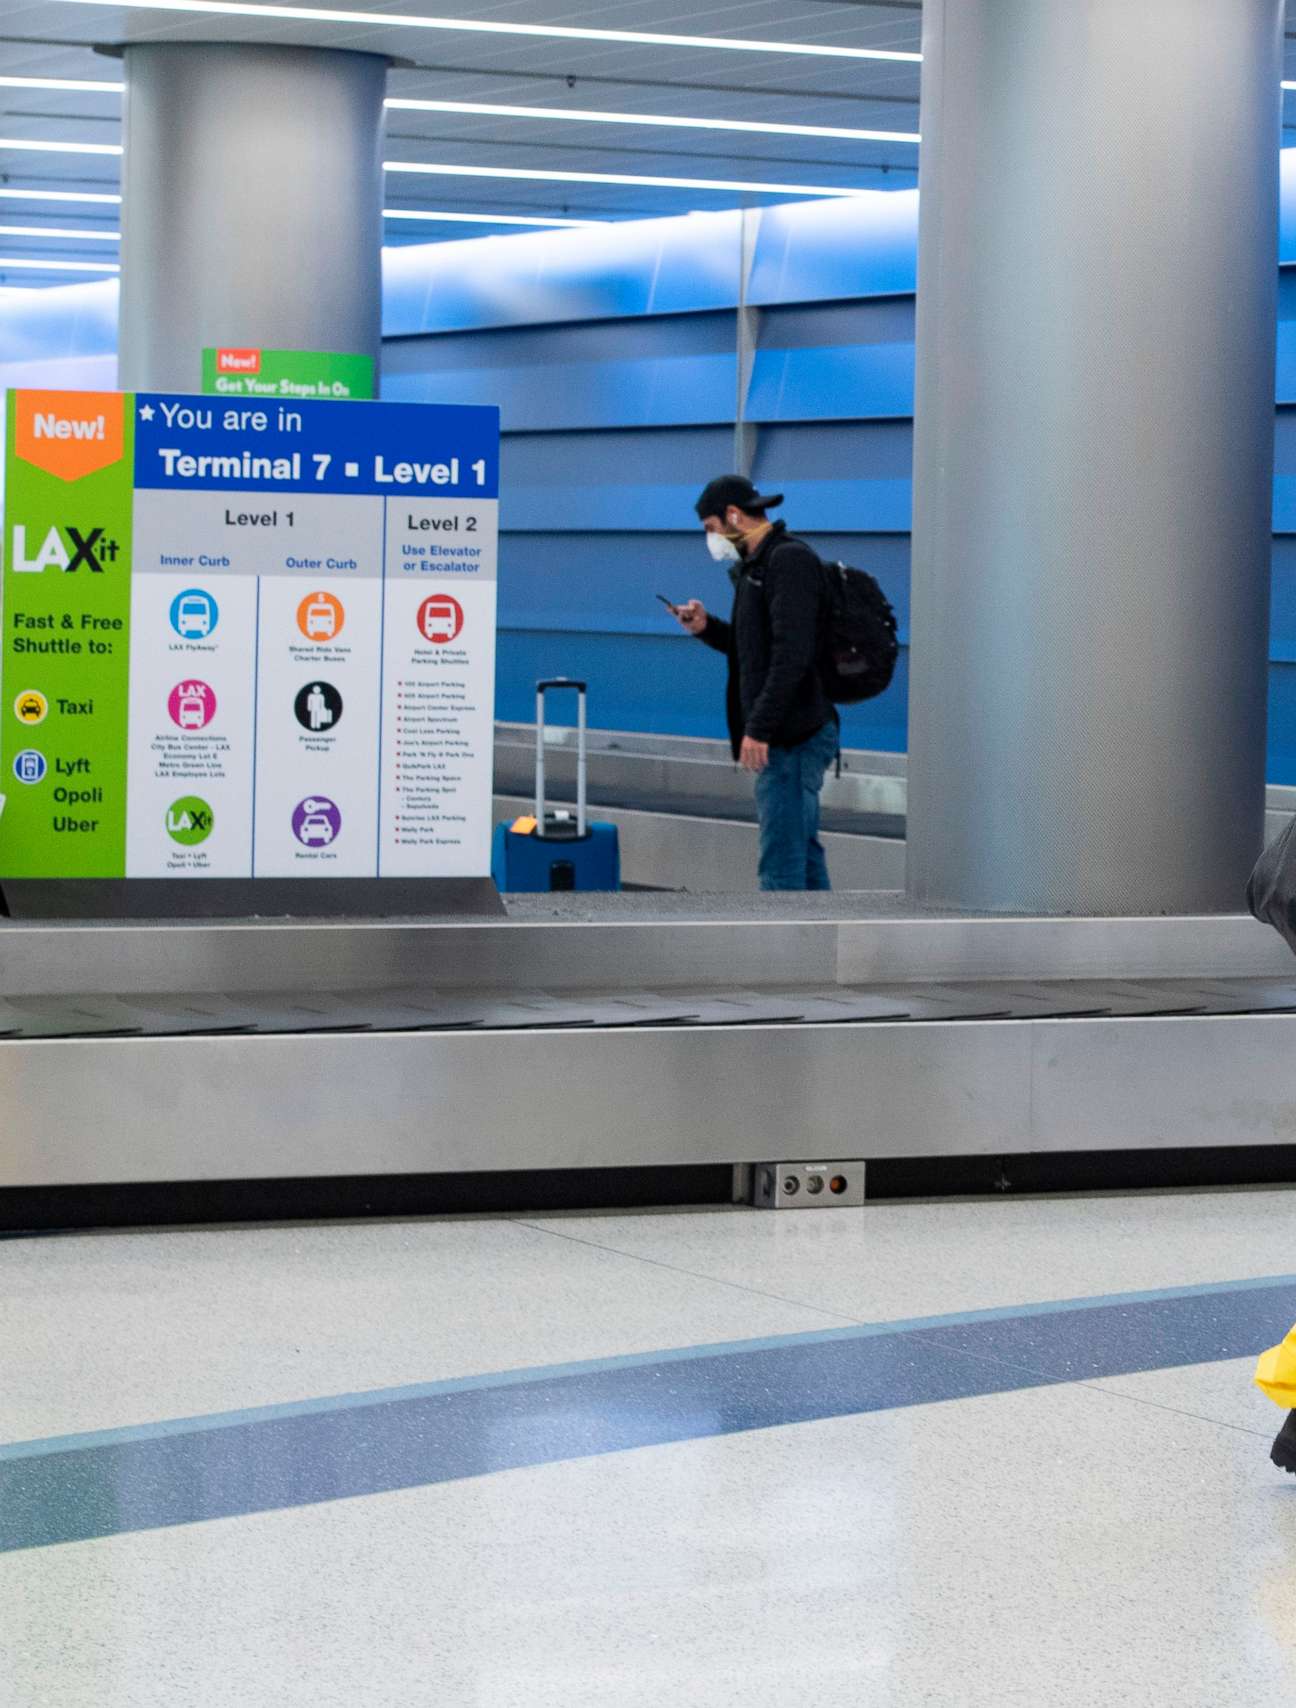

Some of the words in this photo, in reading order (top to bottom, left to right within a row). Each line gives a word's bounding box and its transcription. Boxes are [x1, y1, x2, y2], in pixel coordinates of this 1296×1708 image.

[220, 353, 257, 369] New!
[215, 377, 242, 393] Get
[244, 378, 277, 394] Your
[279, 378, 316, 397] Steps
[318, 381, 330, 396] In
[331, 381, 350, 397] On
[159, 402, 213, 430] You
[222, 408, 267, 432] are
[277, 406, 303, 432] in
[33, 413, 106, 441] New!
[158, 448, 301, 481] Terminal
[312, 453, 332, 480] 7
[373, 455, 459, 485] Level
[471, 460, 487, 486] 1
[225, 510, 278, 528] Level
[285, 511, 295, 528] 1
[407, 514, 458, 533] Level
[464, 516, 477, 533] 2
[401, 544, 425, 557] Use
[428, 544, 482, 559] Elevator
[159, 553, 194, 567] Inner
[197, 553, 231, 568] Curb
[285, 555, 321, 570] Outer
[325, 556, 358, 572] Curb
[402, 562, 415, 572] or
[420, 559, 480, 574] Escalator
[12, 613, 54, 630] Fast
[61, 614, 74, 630] &
[81, 614, 123, 631] Free
[12, 637, 83, 655] Shuttle
[88, 639, 113, 655] to:
[168, 643, 184, 651] LAX
[178, 684, 207, 699] LAX
[56, 698, 94, 715] Taxi
[167, 743, 182, 751] Bus
[216, 743, 231, 752] LAX
[55, 757, 90, 777] Lyft
[155, 770, 170, 778] LAX
[53, 787, 103, 806] Opoli
[53, 816, 100, 833] Uber
